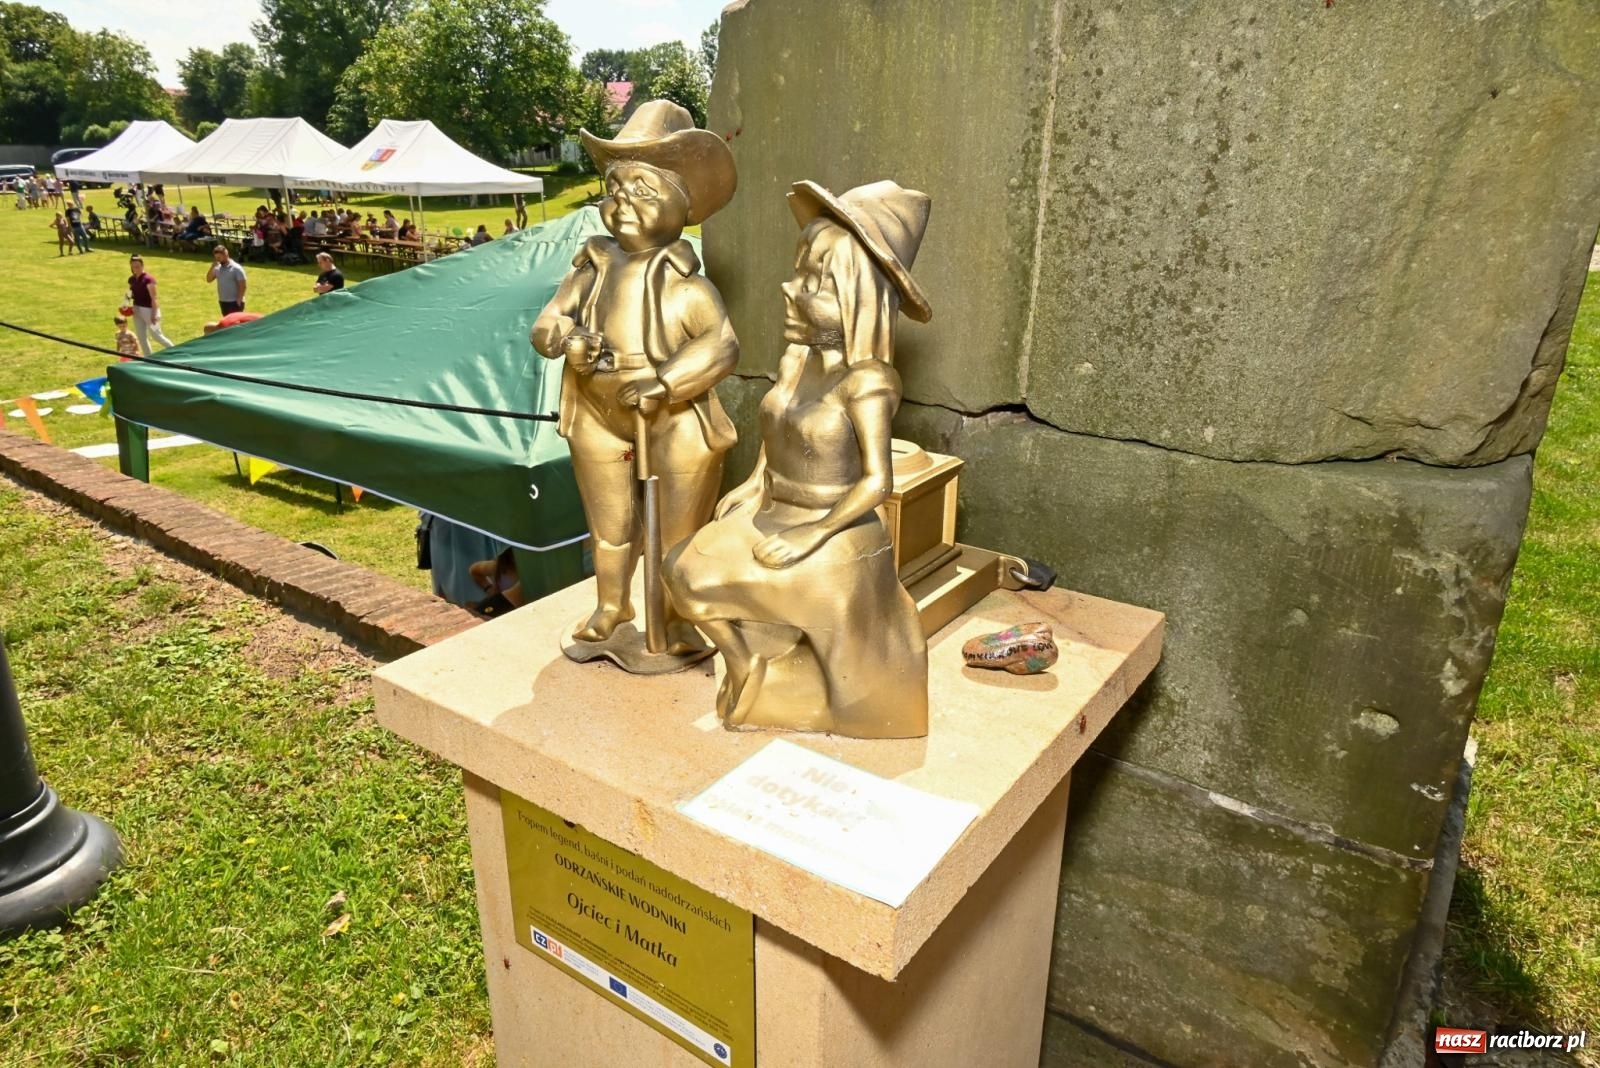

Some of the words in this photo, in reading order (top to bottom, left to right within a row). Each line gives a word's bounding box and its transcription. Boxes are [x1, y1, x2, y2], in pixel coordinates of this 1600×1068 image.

[554, 852, 625, 901] ODRZAŃSKIE
[628, 892, 686, 935] WODNIKI
[567, 893, 612, 930] Ojciec
[615, 919, 621, 934] i
[624, 924, 677, 967] Matka
[584, 844, 609, 867] baśni
[616, 865, 646, 888] podań
[648, 881, 731, 933] nadodrzańskich
